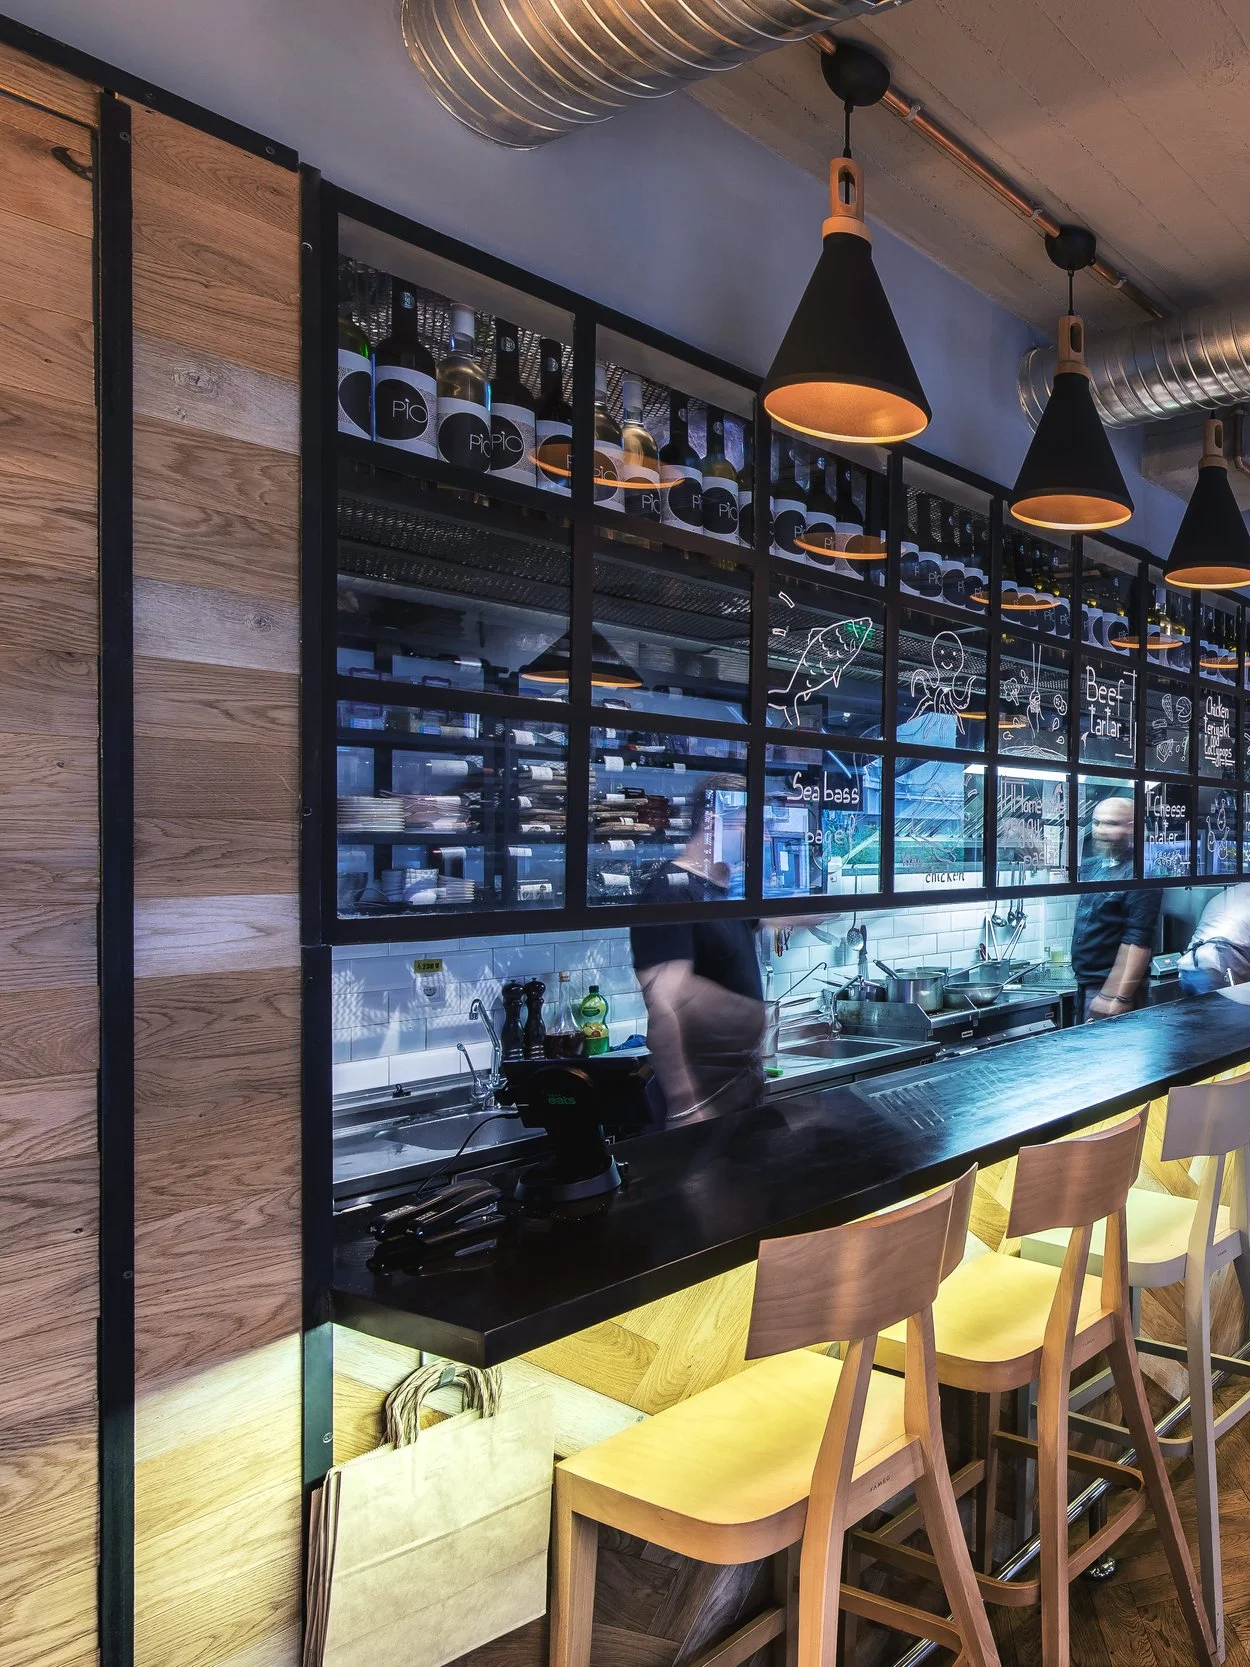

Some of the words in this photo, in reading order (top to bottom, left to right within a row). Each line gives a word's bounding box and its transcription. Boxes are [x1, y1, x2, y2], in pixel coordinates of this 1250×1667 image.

[693, 494, 702, 510] Pi
[1086, 665, 1125, 716] Beef
[1206, 695, 1229, 719] Chicken
[1088, 704, 1122, 738] tartar
[1203, 714, 1231, 740] teriyaki
[1153, 795, 1186, 818] Cheese
[422, 962, 434, 970] 230
[548, 1096, 576, 1105] eats
